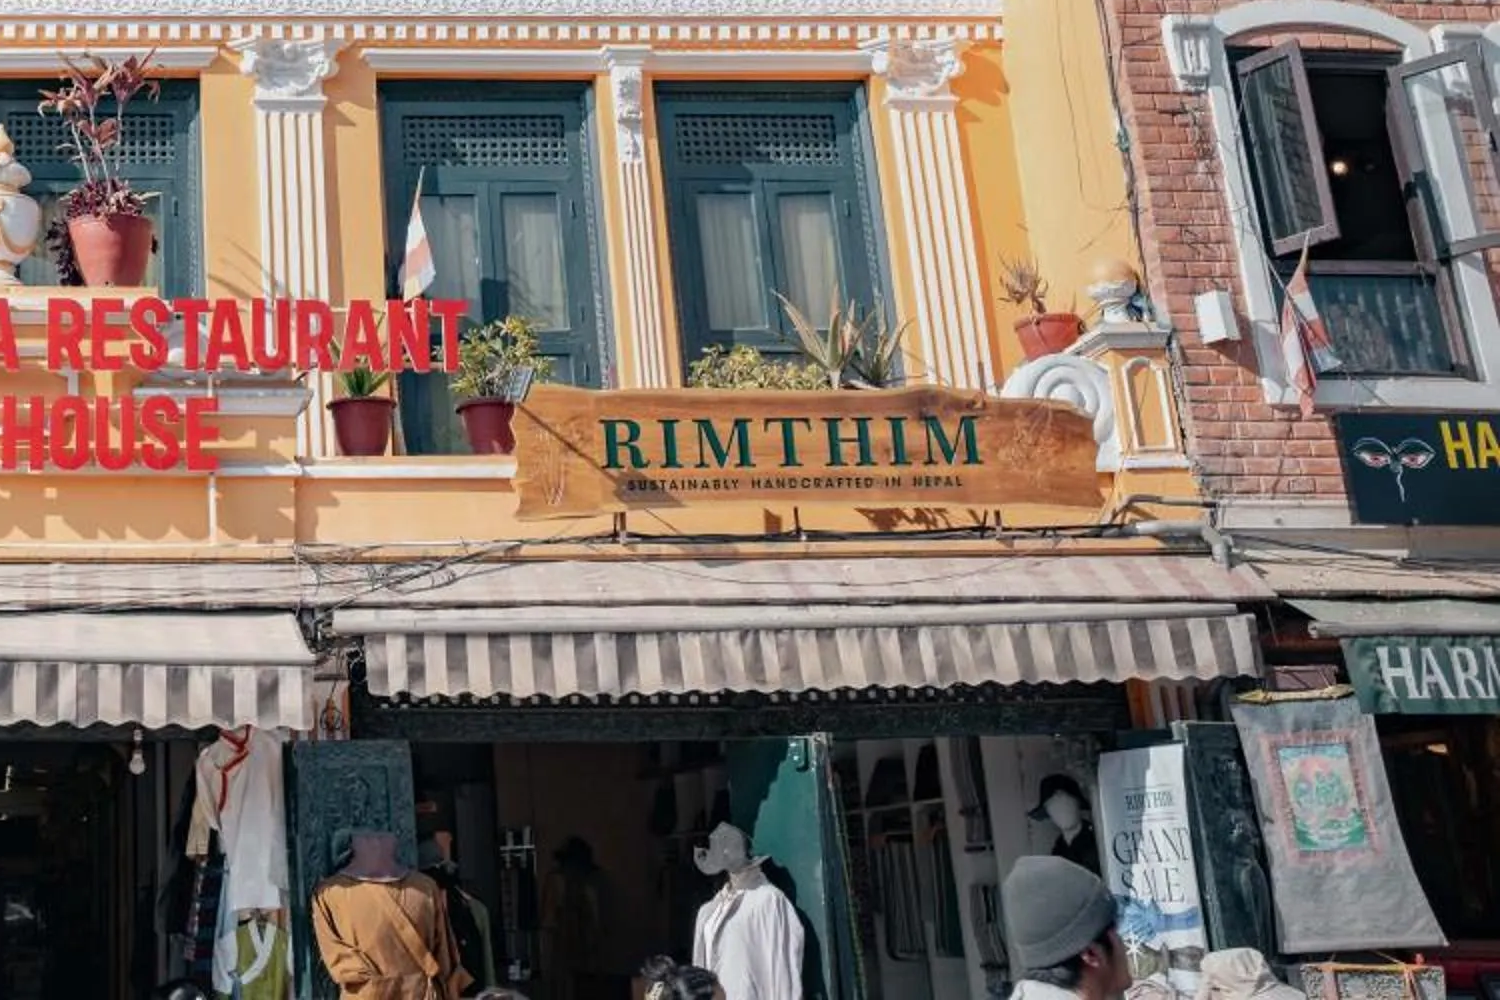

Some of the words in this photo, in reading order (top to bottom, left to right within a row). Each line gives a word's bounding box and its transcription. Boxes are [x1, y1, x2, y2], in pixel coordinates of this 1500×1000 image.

[47, 297, 468, 373] RESTAURANT
[2, 395, 220, 471] HOUSE
[600, 415, 984, 469] RIMTHIM
[626, 478, 740, 491] SUSTAINABLY
[751, 477, 874, 490] HANDCRAFTED
[884, 476, 902, 489] IN
[912, 475, 964, 488] NEPAL
[1121, 867, 1186, 903] SALE
